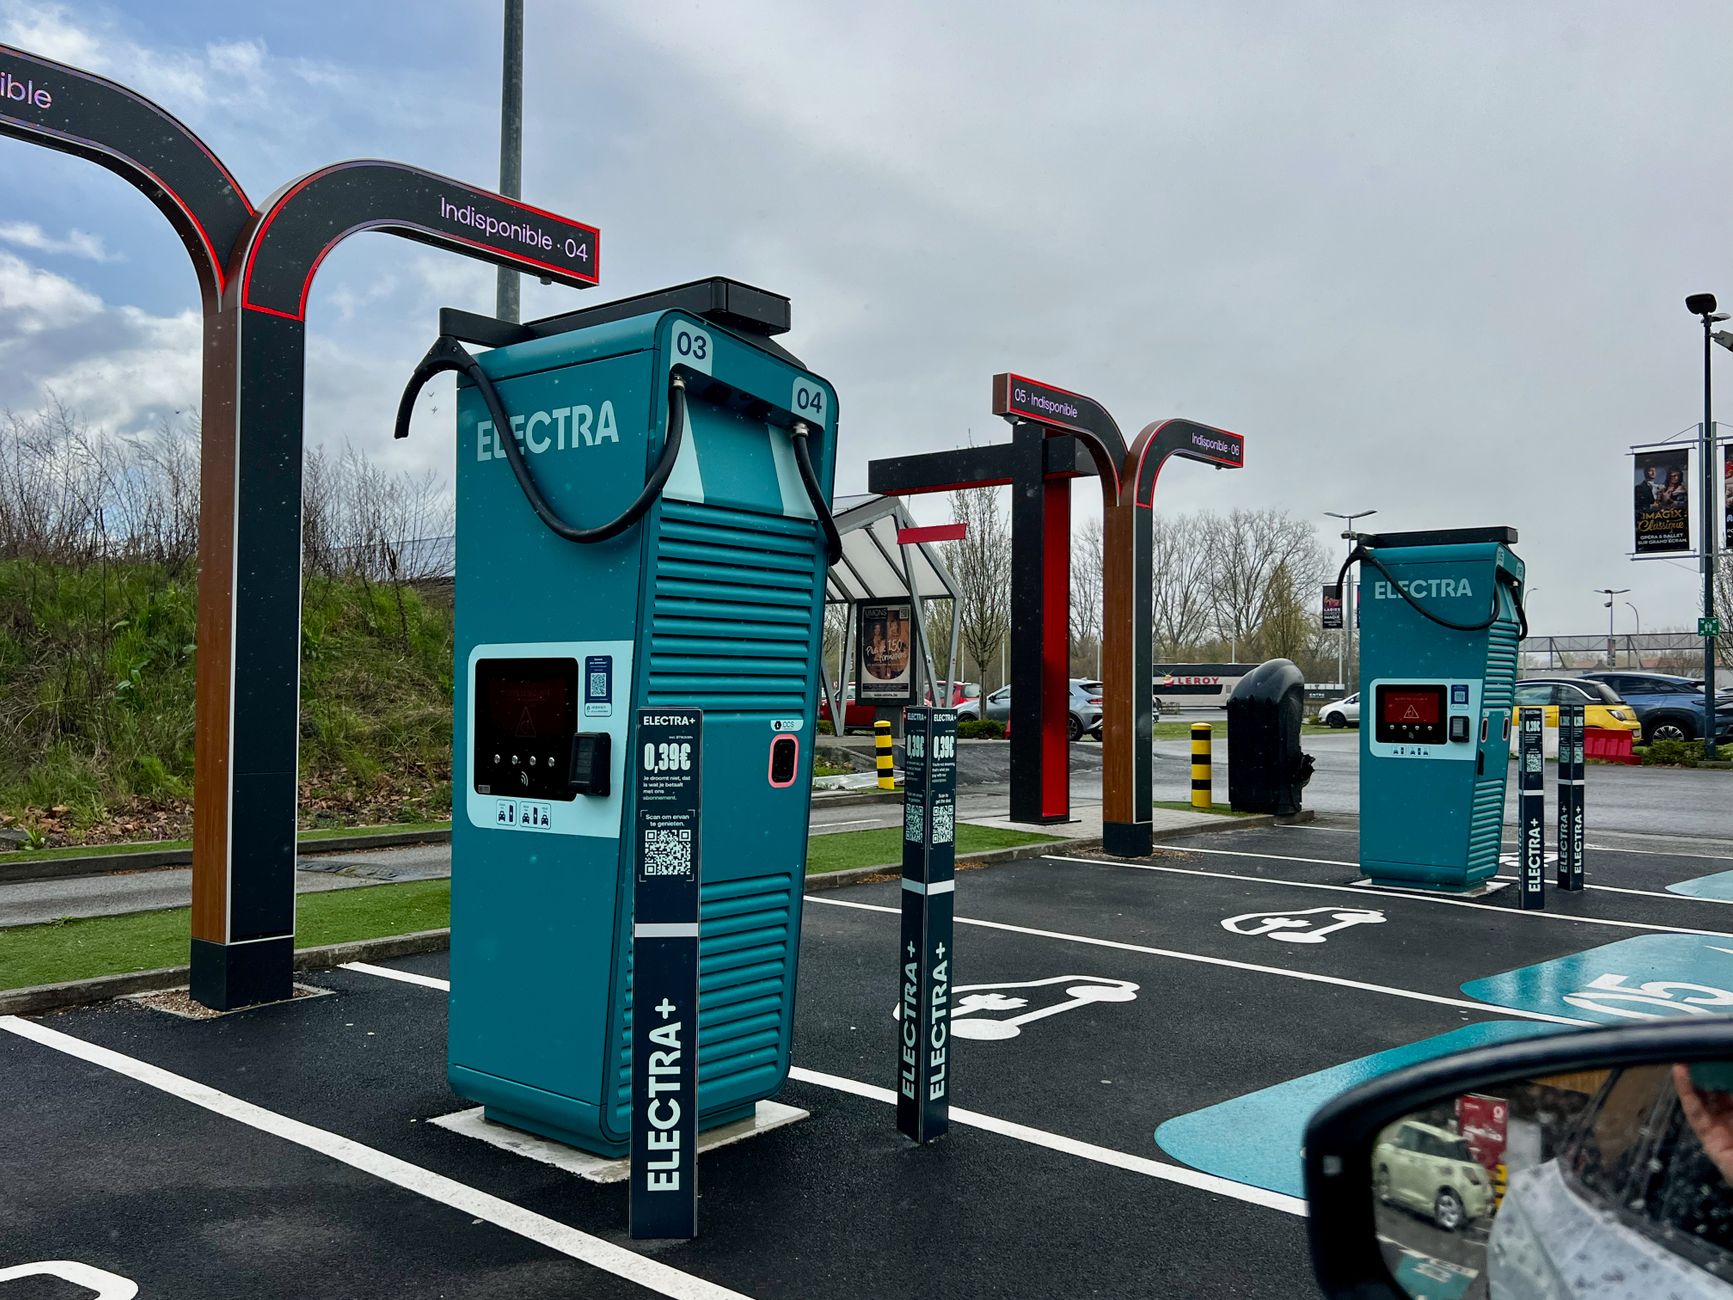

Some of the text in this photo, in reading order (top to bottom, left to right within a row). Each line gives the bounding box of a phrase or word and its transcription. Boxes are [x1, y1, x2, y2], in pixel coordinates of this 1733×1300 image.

[441, 197, 588, 262] Indisponible 04
[677, 331, 707, 360] 03
[797, 387, 822, 413] 04
[1014, 388, 1078, 418] 05 Indisponible
[477, 400, 620, 462] ELECTRA
[1191, 432, 1240, 456] Indisponible 06
[1642, 509, 1682, 520] IMAGIX
[1374, 577, 1473, 600] ELECTRA
[888, 638, 903, 652] 150
[1177, 677, 1220, 685] LEROY
[643, 715, 696, 726] ELECTRA+
[933, 713, 957, 722] ELECTRA+
[644, 742, 691, 774] 0,39€
[933, 735, 955, 760] 0,39€
[1560, 805, 1568, 873] ELECTRA+
[1574, 805, 1582, 874] ELECTRA+
[1528, 817, 1541, 892] ELECTRA+
[902, 940, 918, 1100] ELECTRA+
[930, 941, 948, 1101] ELECTRA+
[647, 997, 682, 1192] ELECTRA+
